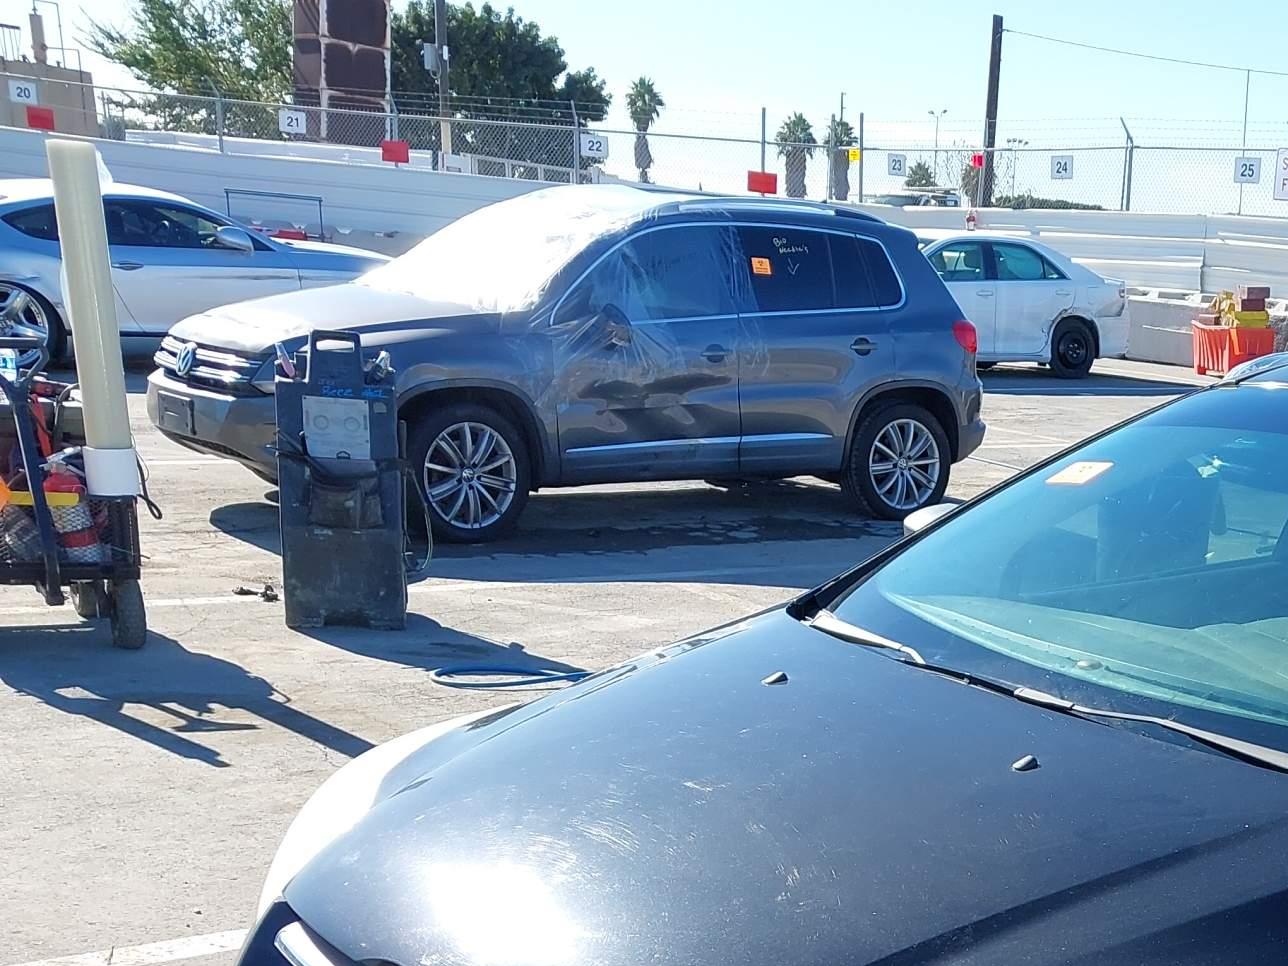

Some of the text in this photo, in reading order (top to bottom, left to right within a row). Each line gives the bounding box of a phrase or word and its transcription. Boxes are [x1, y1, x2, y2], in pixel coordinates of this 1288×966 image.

[15, 86, 31, 99] 20
[286, 116, 300, 128] 21
[587, 140, 602, 152] 22
[891, 158, 902, 172] 23
[1055, 161, 1068, 174] 24
[1240, 163, 1255, 178] 25
